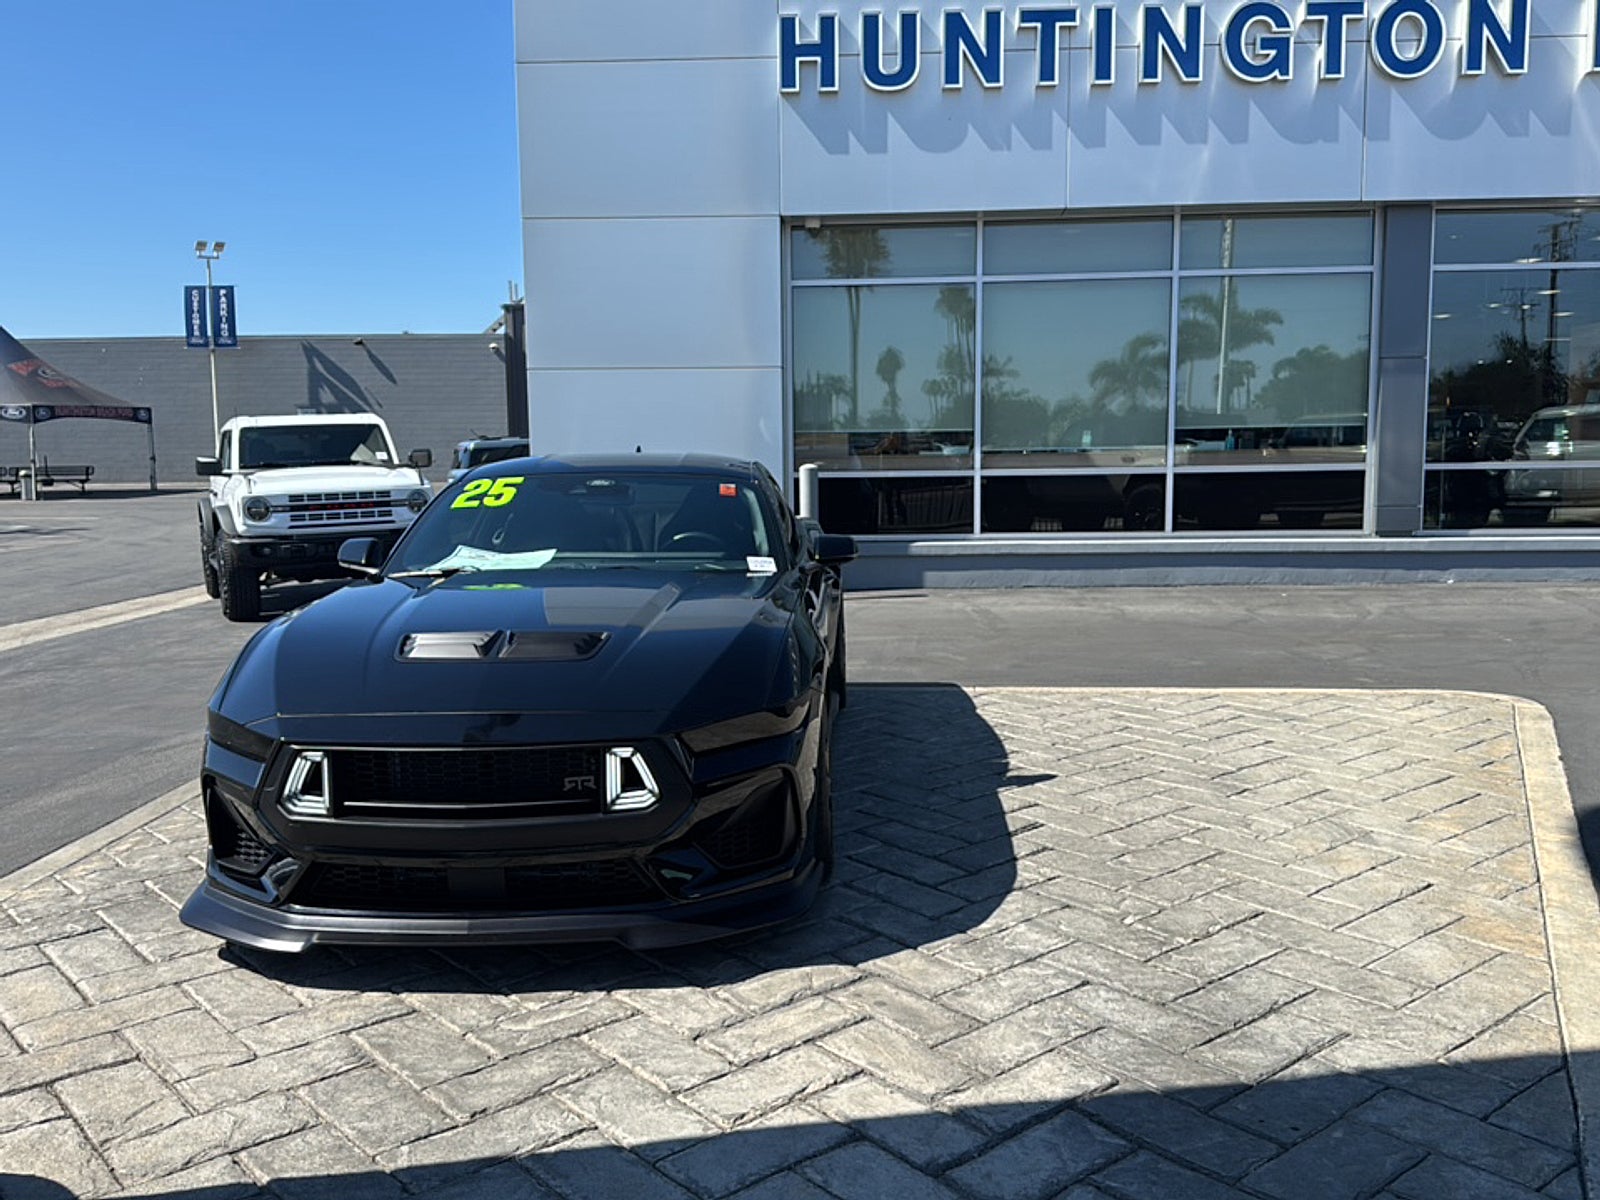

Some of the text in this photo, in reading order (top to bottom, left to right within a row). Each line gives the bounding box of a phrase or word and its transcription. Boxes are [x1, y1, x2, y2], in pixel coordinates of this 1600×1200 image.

[779, 0, 1530, 93] HUNTINGTON
[191, 289, 200, 336] CUSTOMER
[219, 288, 229, 337] PARKING
[451, 476, 525, 509] 25
